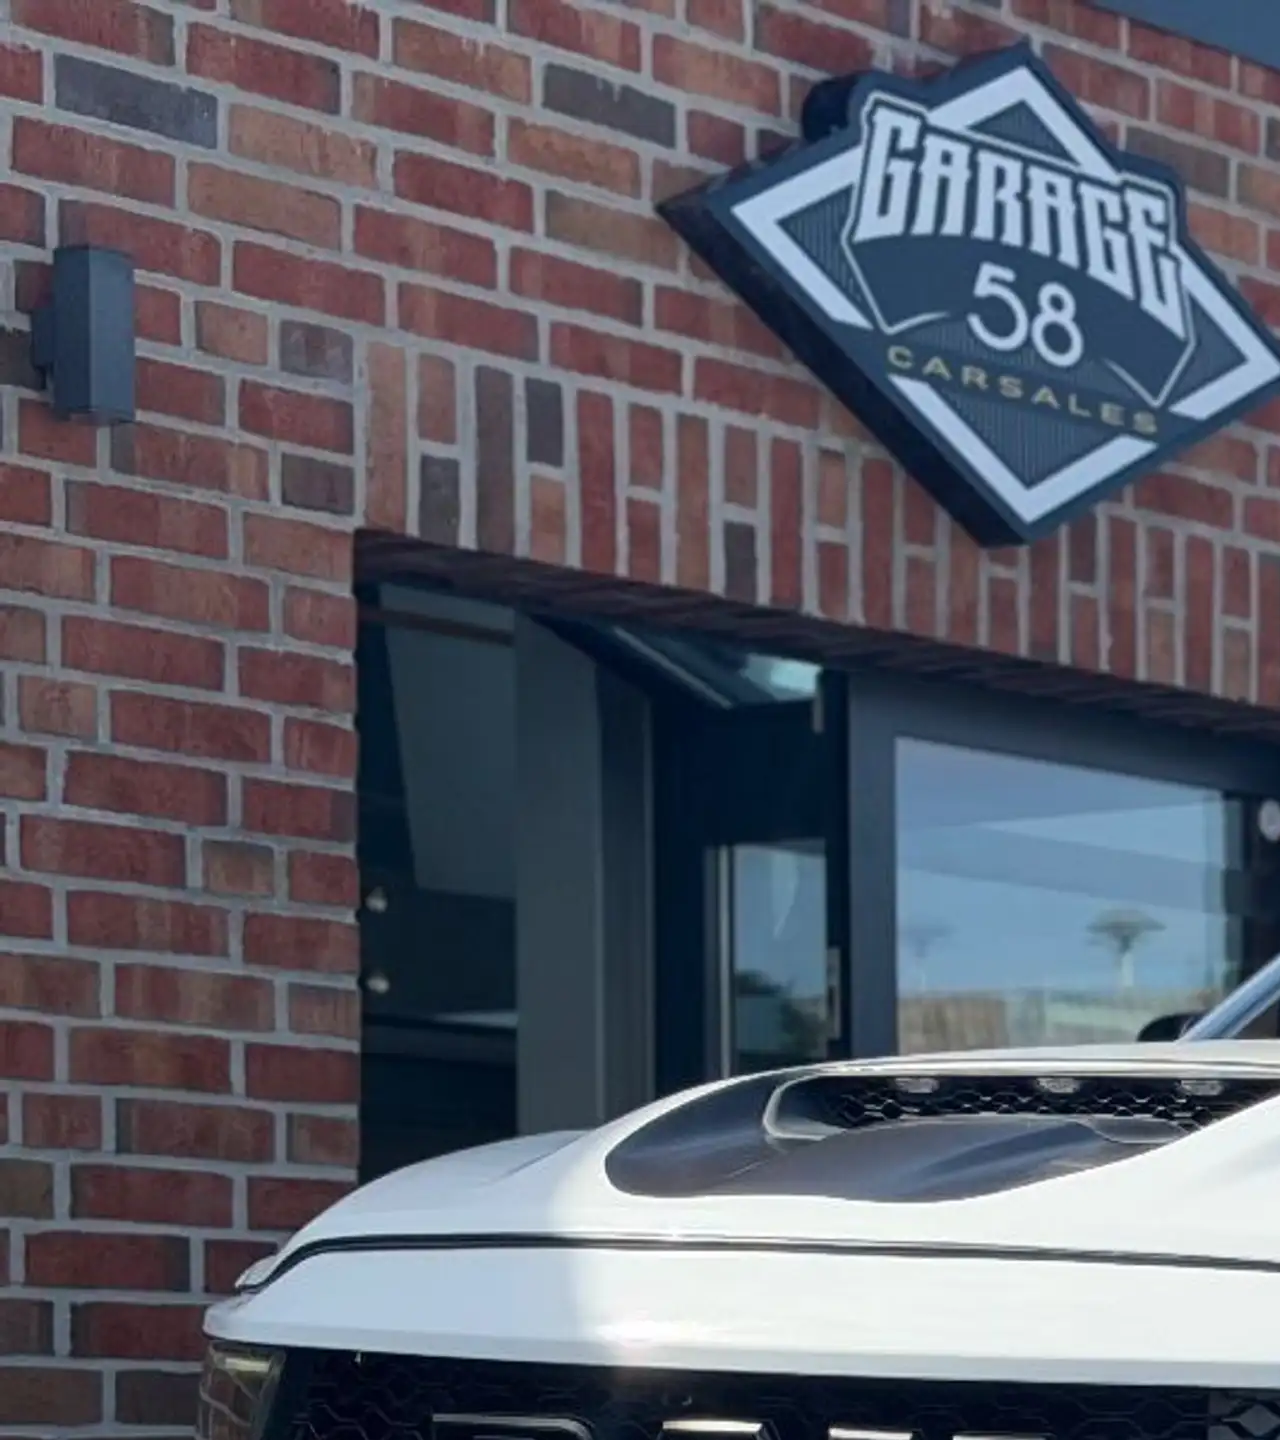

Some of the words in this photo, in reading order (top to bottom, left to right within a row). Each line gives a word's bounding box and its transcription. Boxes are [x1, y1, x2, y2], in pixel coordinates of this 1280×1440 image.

[852, 106, 1188, 341] GARAGE
[966, 261, 1084, 368] 58
[886, 344, 1158, 434] CARSALES
